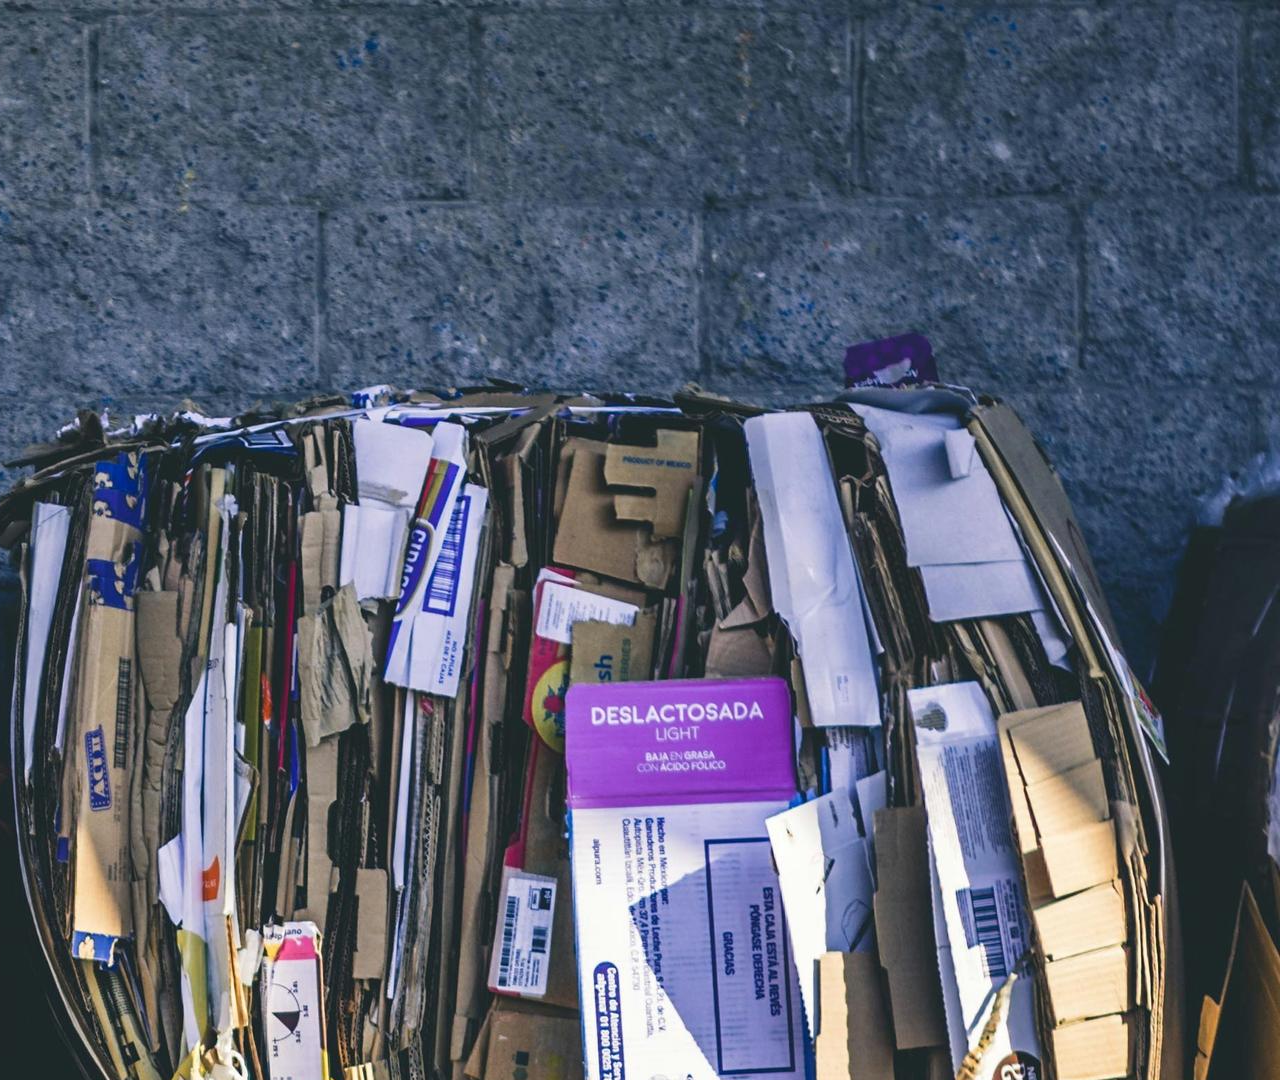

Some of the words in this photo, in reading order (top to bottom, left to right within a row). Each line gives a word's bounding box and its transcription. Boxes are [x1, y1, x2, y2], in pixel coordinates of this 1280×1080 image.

[624, 456, 654, 465] PRODUCT
[396, 528, 427, 612] CIDAC
[450, 640, 458, 651] NO
[447, 651, 456, 677] APILAR
[591, 702, 764, 725] DESLACTOSADA
[656, 726, 700, 742] LIGHT
[637, 763, 659, 773] CON
[660, 760, 690, 771] ÁCIDO
[690, 760, 726, 771] FÓLICO
[645, 752, 669, 762] BAJA
[670, 752, 682, 761] EN
[683, 751, 715, 761] GRASA
[92, 757, 107, 797] ACT
[634, 818, 643, 856] Autopista
[645, 818, 654, 861] Ganaderos
[657, 817, 666, 843] Hecho
[593, 838, 602, 886] alpura.com
[659, 845, 666, 855] en
[660, 857, 668, 888] México
[648, 863, 657, 913] Productores
[762, 887, 774, 912] ESTA
[652, 914, 659, 926] de
[750, 904, 762, 951] PÓNGASE
[764, 913, 776, 940] CAJA
[653, 927, 661, 952] Leche
[722, 931, 735, 976] GRACIAS
[766, 942, 779, 967] ESTÁ
[607, 967, 617, 998] Centro
[752, 953, 765, 1000] DERECHA
[768, 967, 778, 983] AL
[609, 999, 618, 1011] de
[769, 984, 782, 1017] REVÉS
[600, 1015, 609, 1027] 01
[610, 1012, 621, 1053] Atención
[601, 1029, 610, 1047] 800
